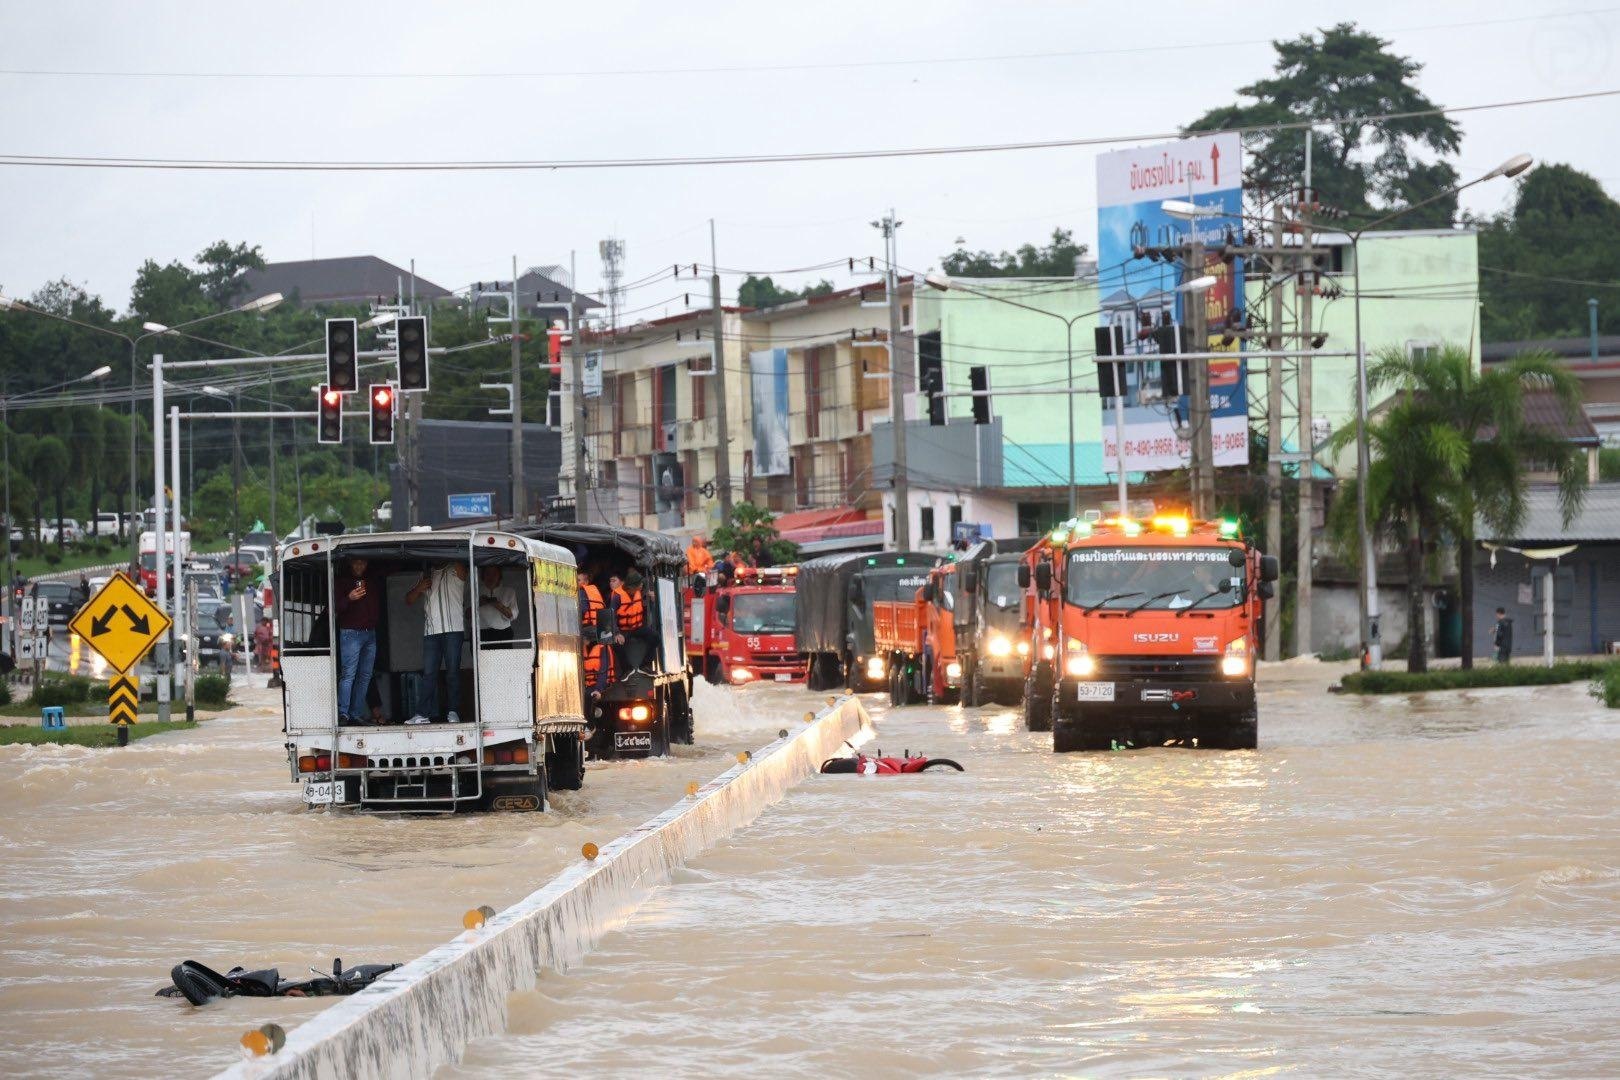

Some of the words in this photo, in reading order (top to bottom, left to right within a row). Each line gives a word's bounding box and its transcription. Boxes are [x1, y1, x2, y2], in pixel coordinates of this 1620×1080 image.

[1072, 549, 1230, 563] กรมป้องกันและบรรเทาสาธารณ
[747, 637, 760, 648] 55
[1133, 633, 1179, 642] ISUZU
